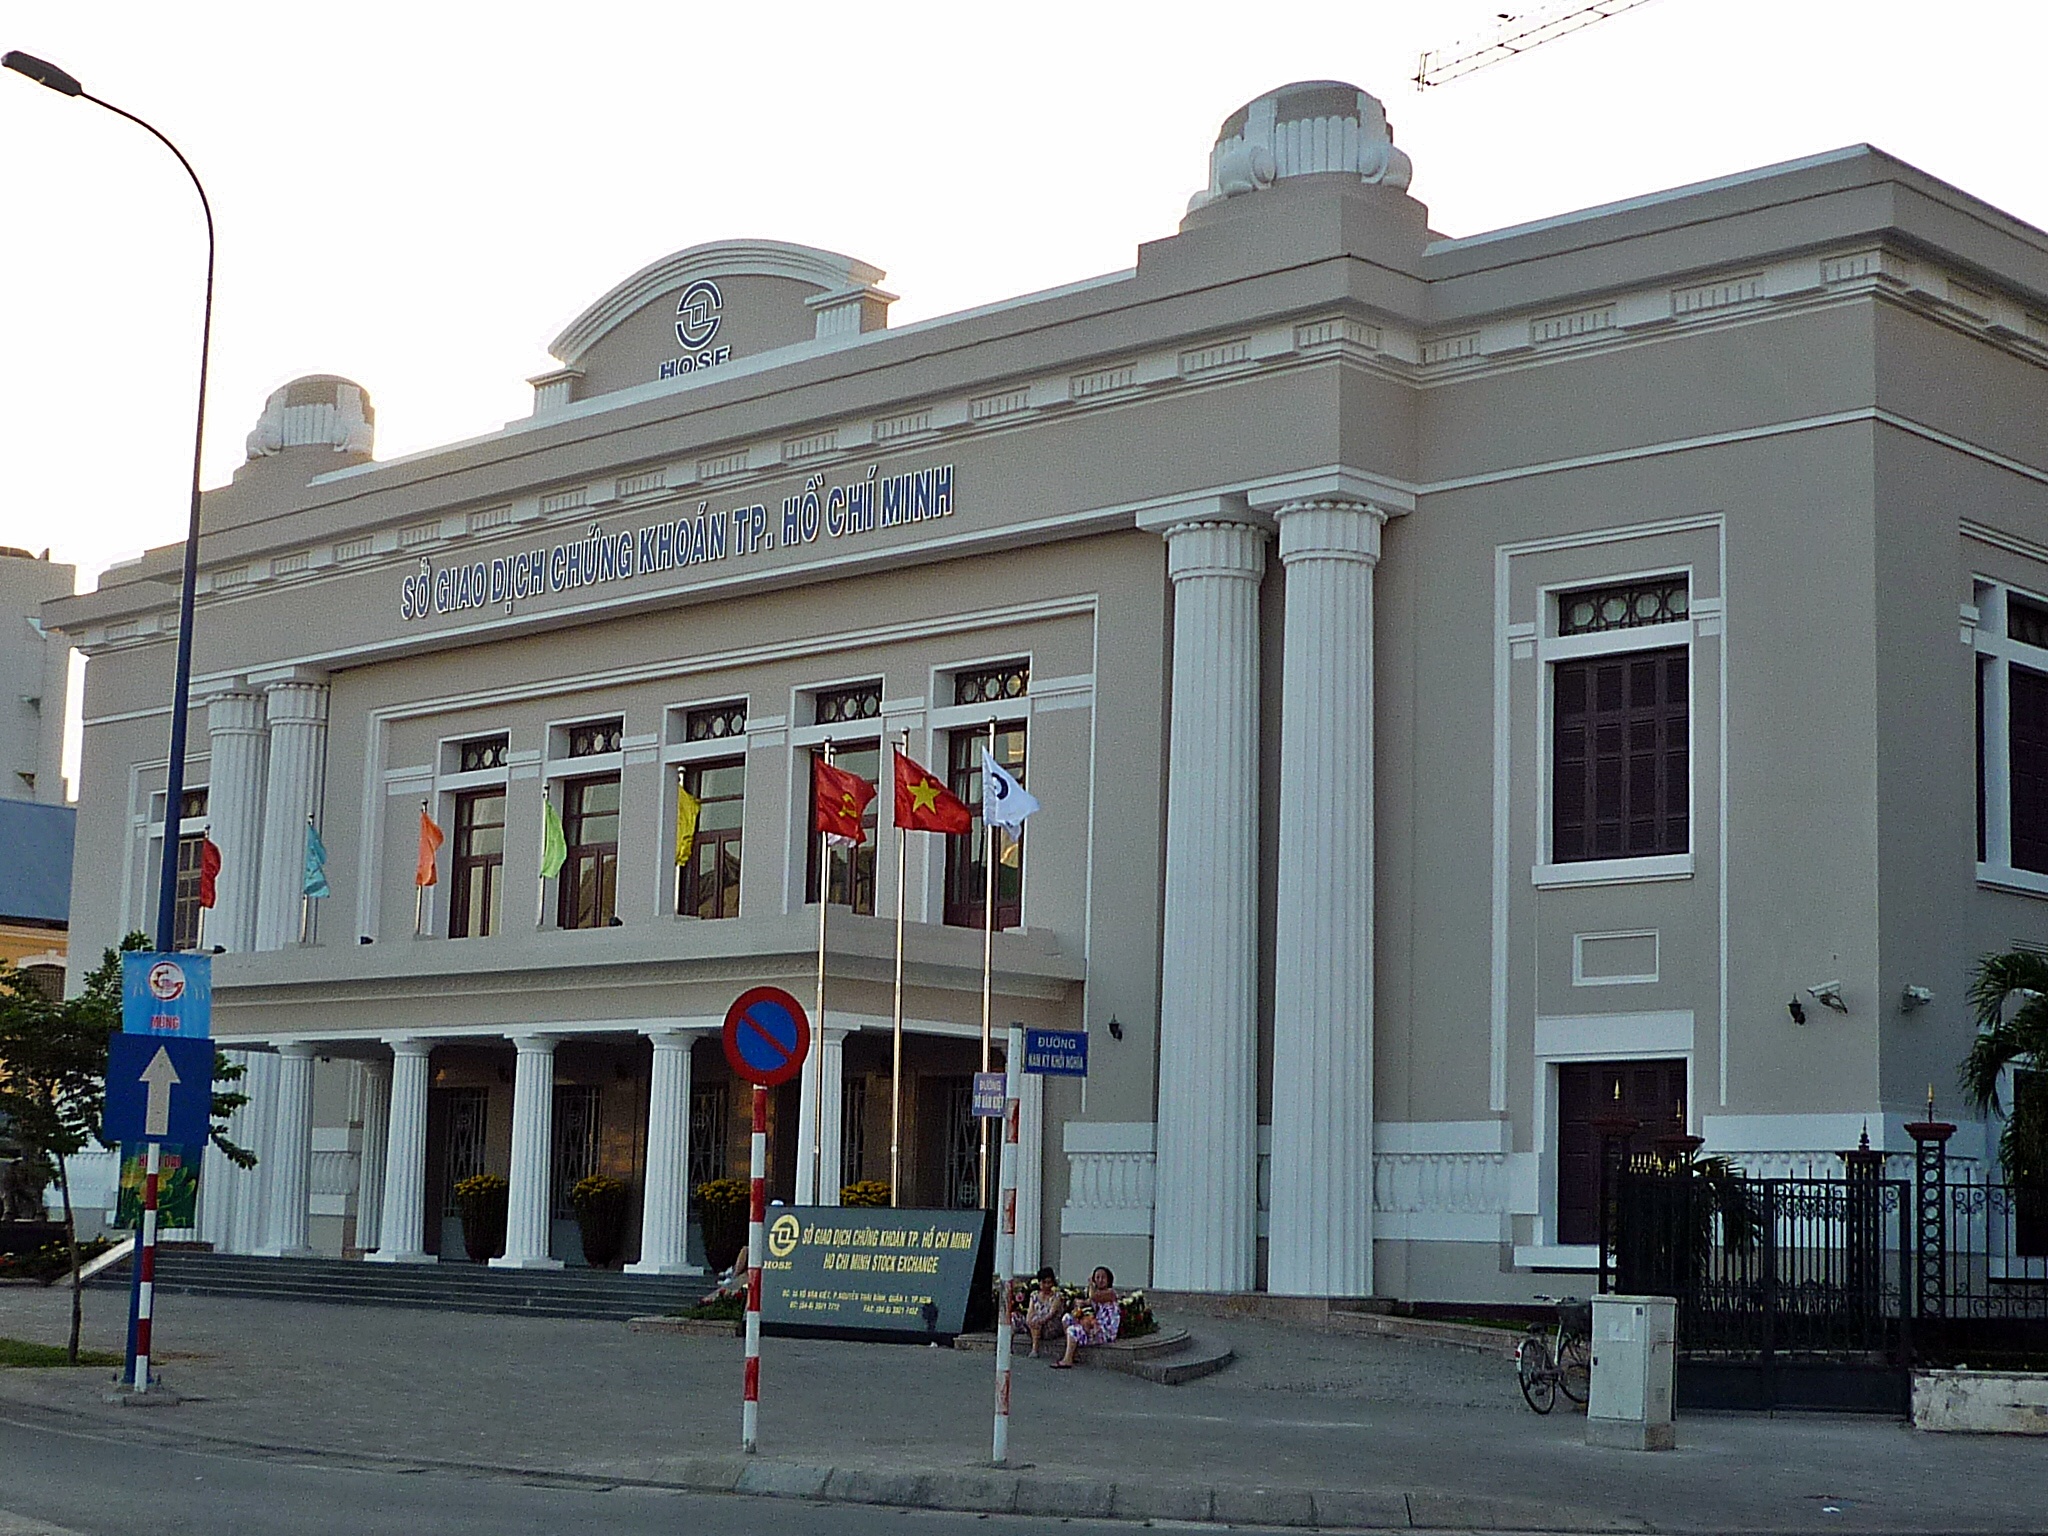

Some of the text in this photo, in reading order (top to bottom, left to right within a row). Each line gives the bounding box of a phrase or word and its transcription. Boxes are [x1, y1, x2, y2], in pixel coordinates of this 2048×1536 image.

[659, 345, 730, 380] HOSE
[401, 464, 954, 619] SỞ GIAO DỊCH CHỨNG KHOÁN TP. HỒ CHÍ MINH
[1038, 1034, 1076, 1050] ĐƯỜNG
[802, 1222, 814, 1245] SỞ
[814, 1228, 833, 1246] GIAO
[833, 1228, 852, 1248] DỊCH
[853, 1226, 879, 1247] CHỨNG
[880, 1226, 907, 1247] KHOÁN
[907, 1230, 919, 1248] TP.
[935, 1228, 951, 1249] CHÍ
[950, 1231, 973, 1249] MINH
[763, 1260, 793, 1269] HOSE
[823, 1251, 939, 1273] HO CHI MINH STOCK EXCHANGE
